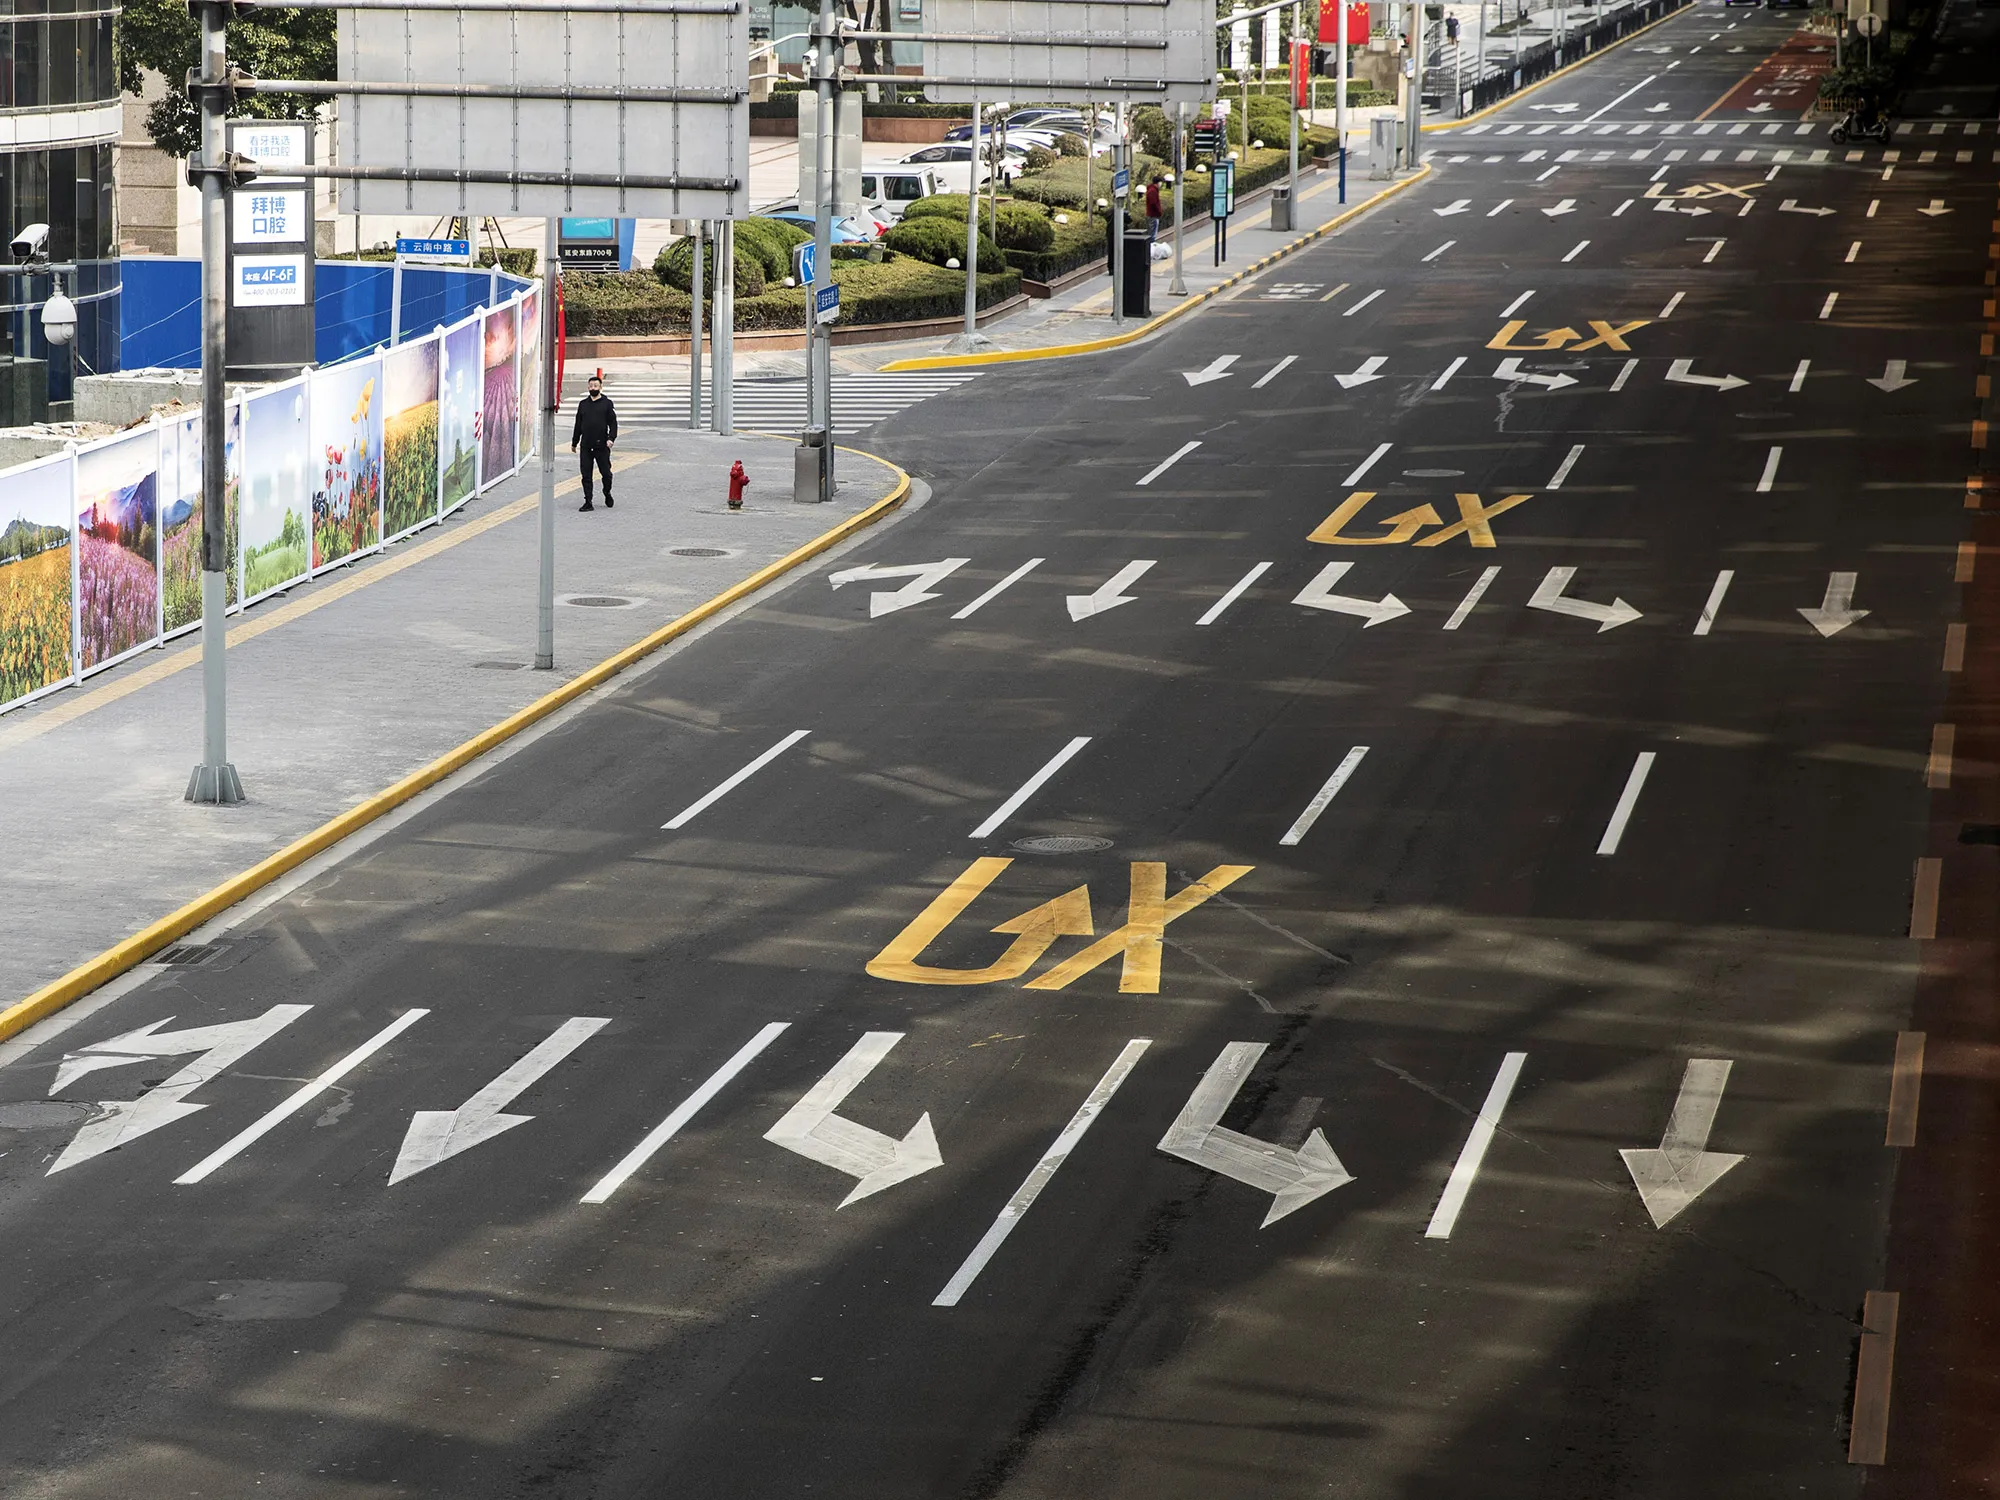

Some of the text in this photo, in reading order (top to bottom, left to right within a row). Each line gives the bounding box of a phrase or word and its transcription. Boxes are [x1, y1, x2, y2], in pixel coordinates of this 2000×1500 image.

[250, 136, 290, 146] 看牙我选
[250, 146, 290, 157] 拜博口腔
[252, 197, 286, 214] 拜博
[252, 217, 286, 234] 口腔
[413, 242, 452, 253] 云南中路
[564, 249, 612, 257] 延安东路700号
